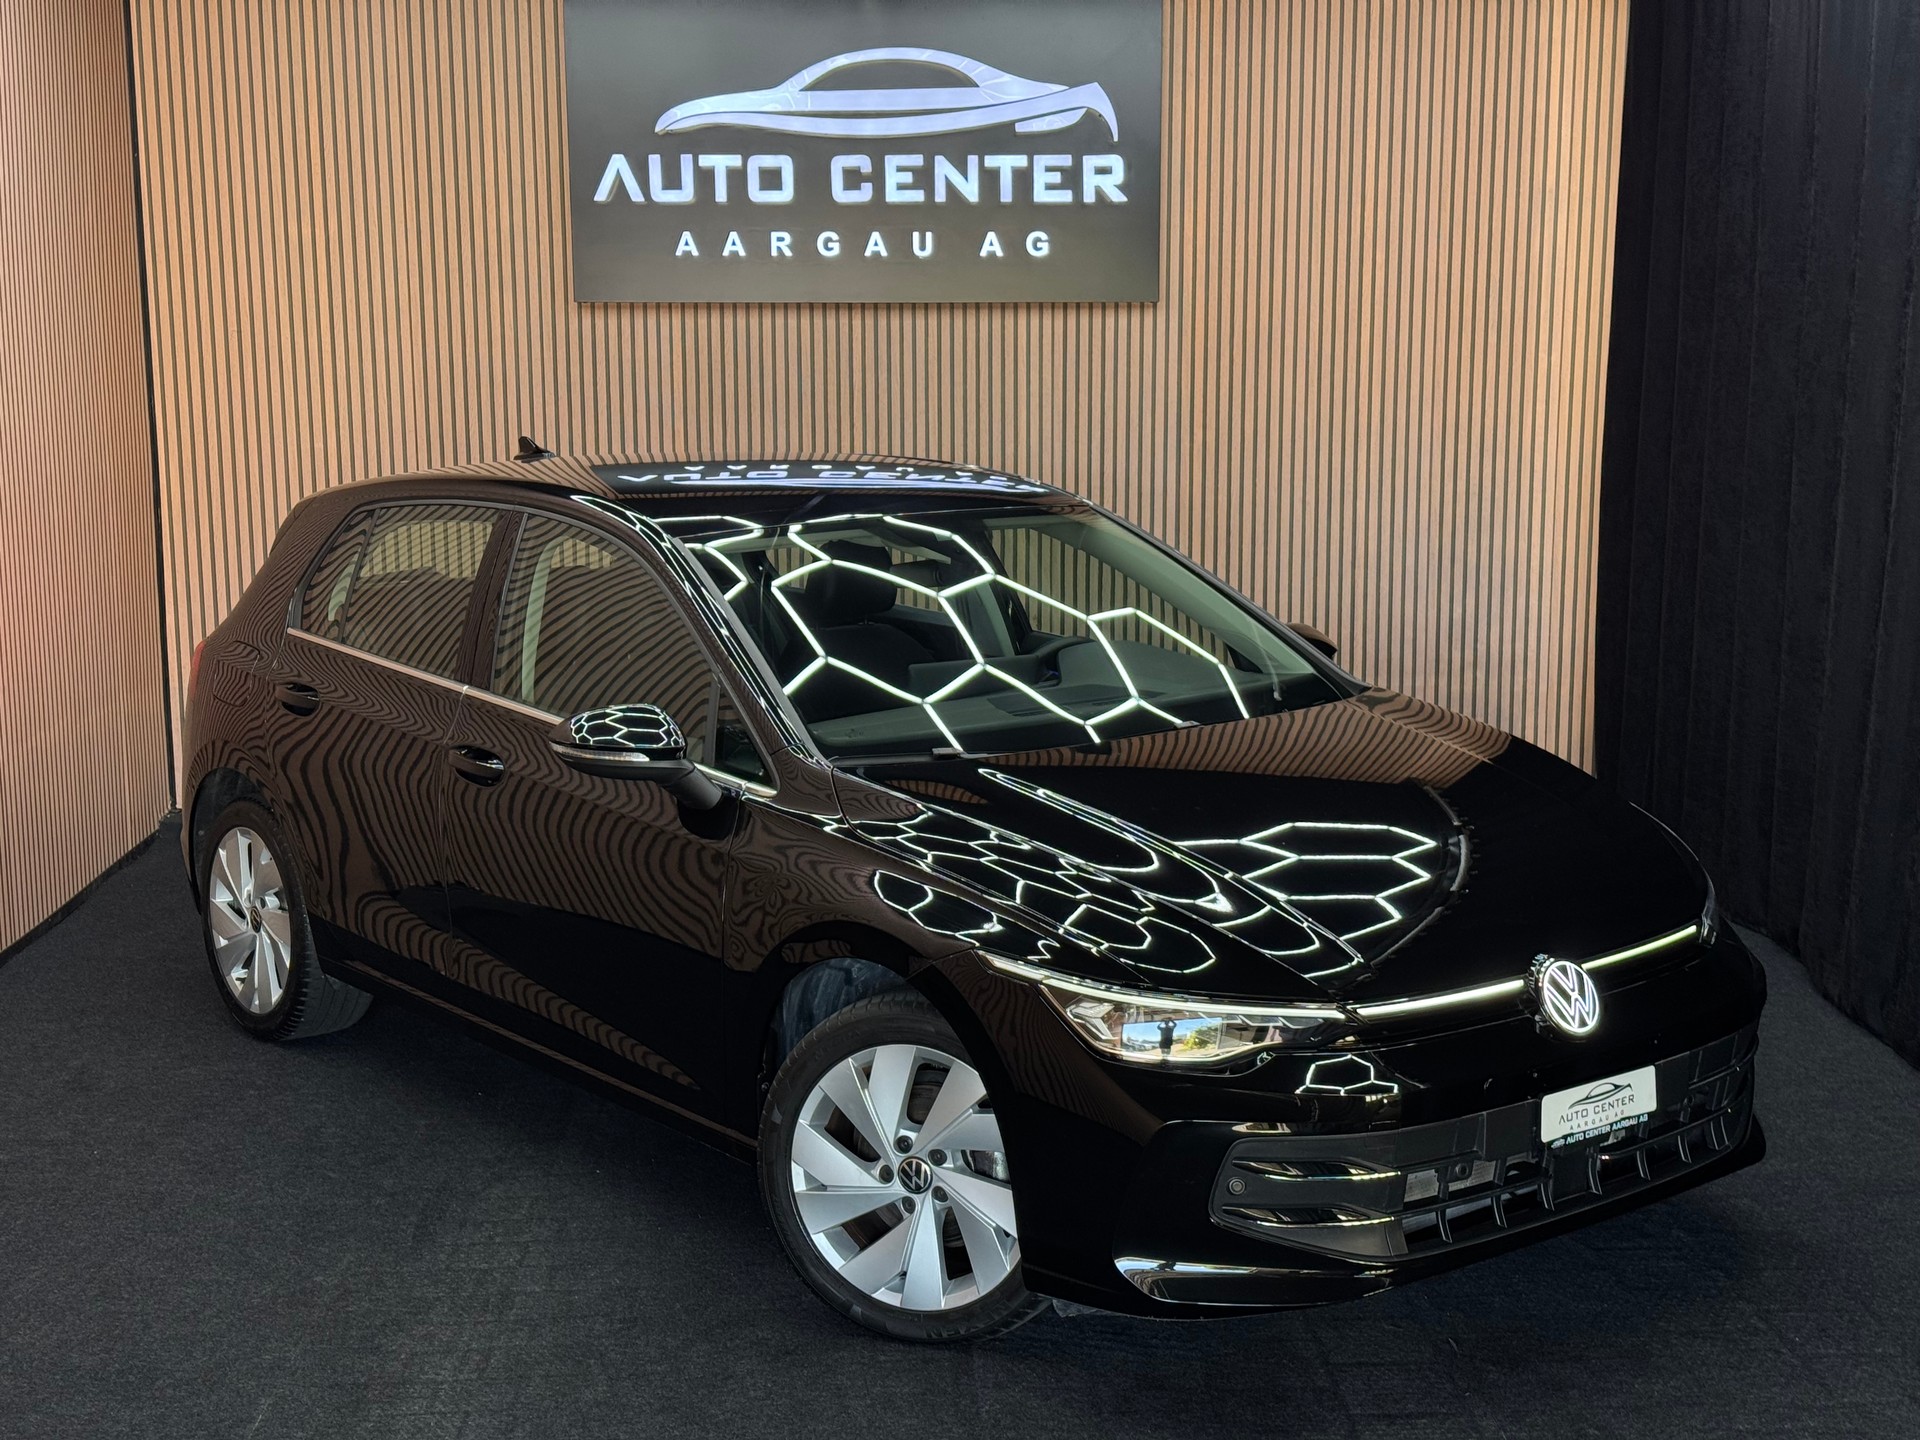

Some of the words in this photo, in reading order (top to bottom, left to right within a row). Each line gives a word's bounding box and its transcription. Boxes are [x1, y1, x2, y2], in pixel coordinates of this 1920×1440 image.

[593, 153, 794, 204] AUTO
[830, 153, 1128, 204] CENTER
[675, 230, 934, 258] AARGAU
[979, 230, 1051, 257] AG
[1558, 1108, 1589, 1125] AUTO
[1593, 1094, 1635, 1115] CENTER
[1566, 1132, 1584, 1145] AUTO
[1585, 1125, 1611, 1138] CENTER
[1611, 1117, 1638, 1131] AARGAU
